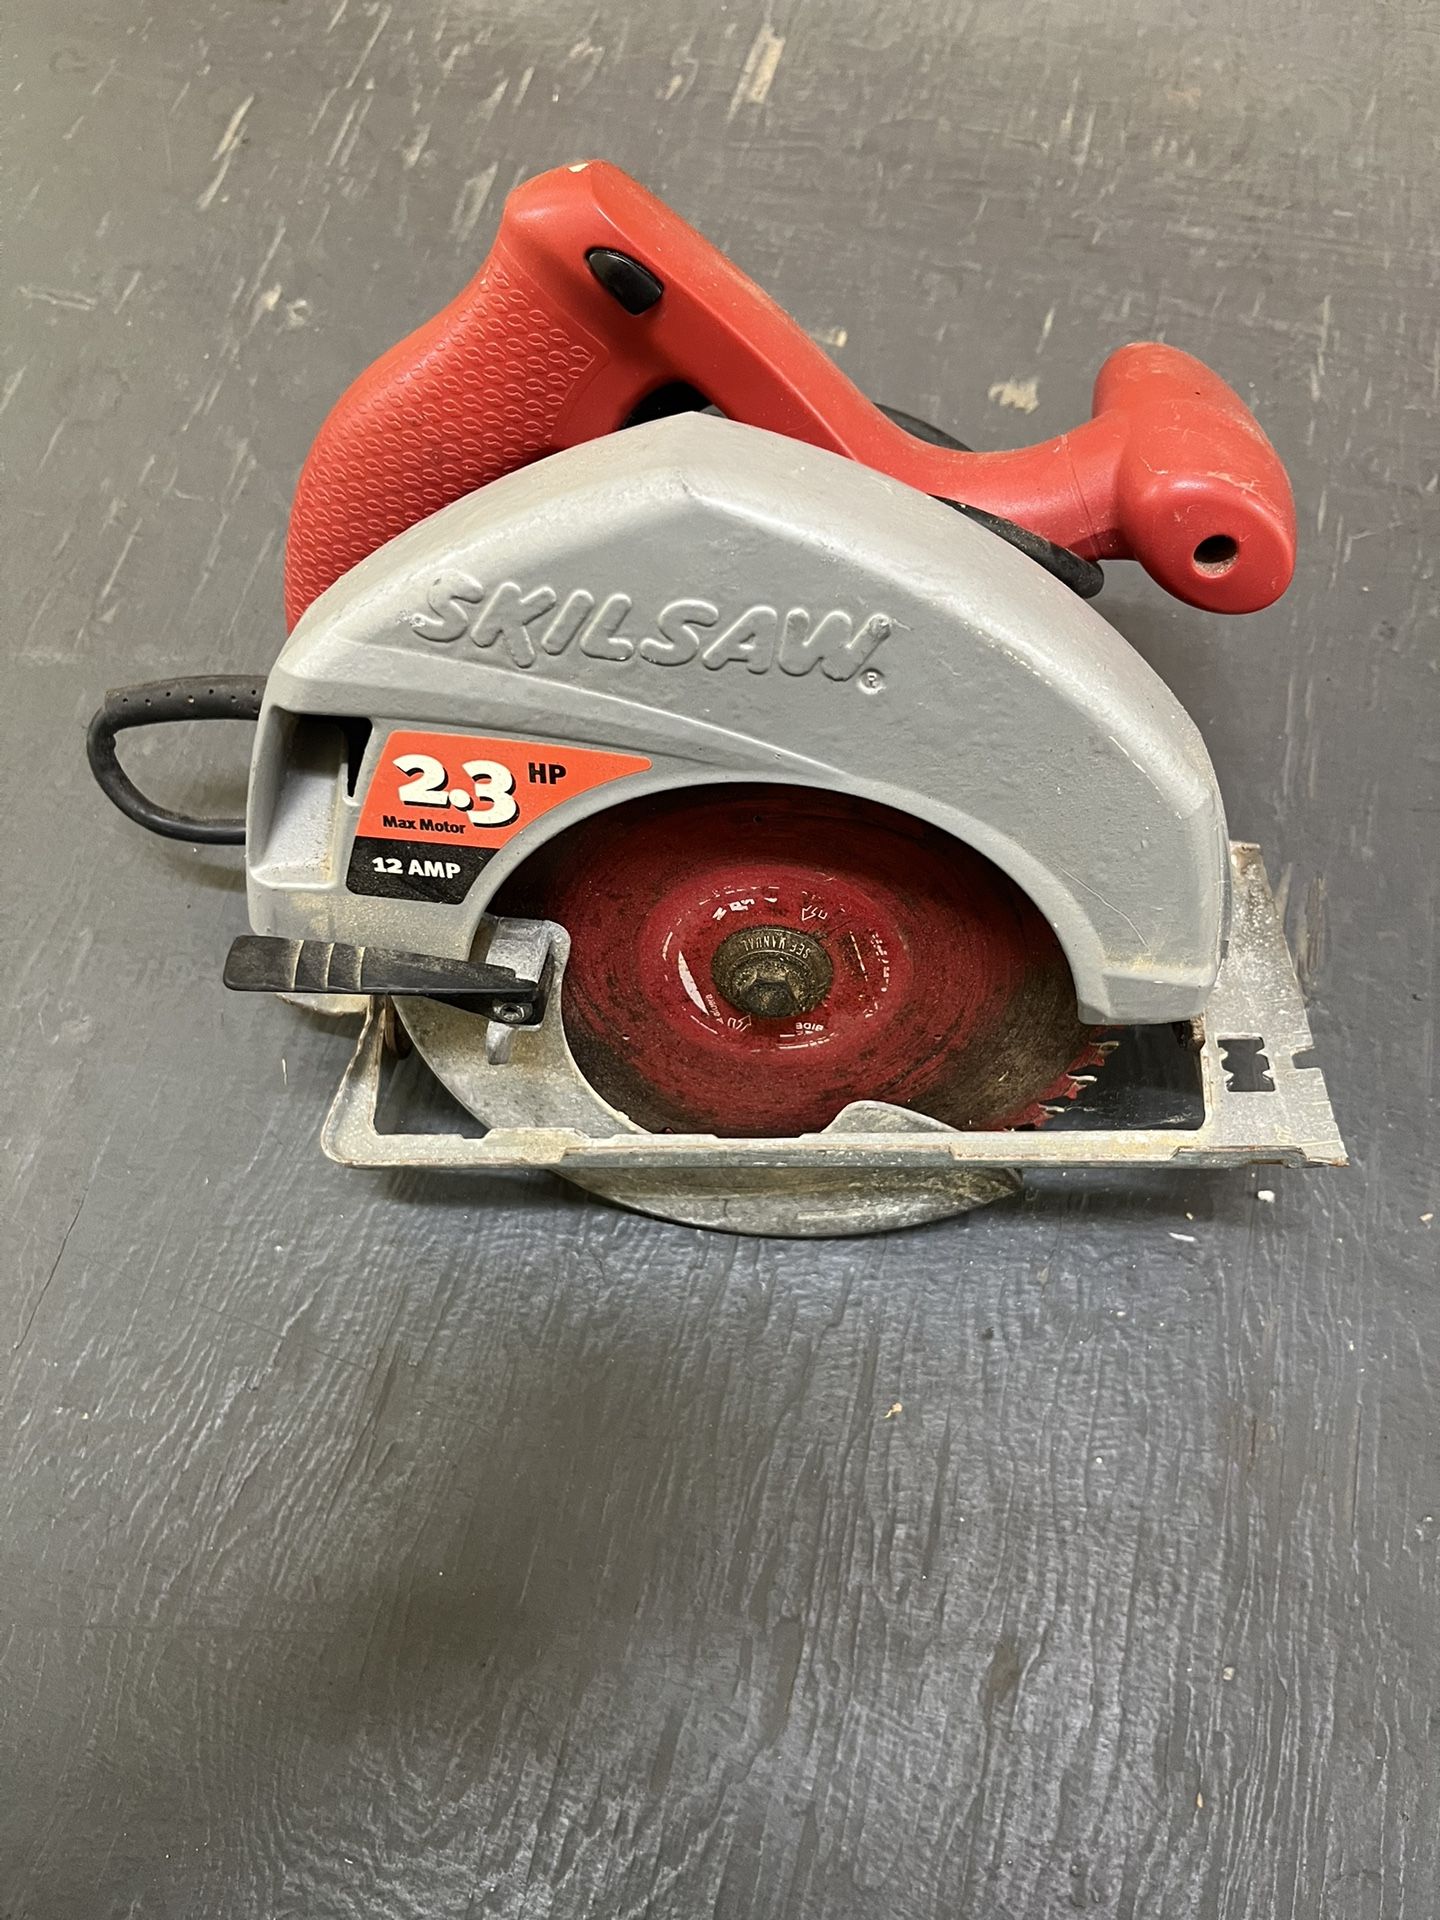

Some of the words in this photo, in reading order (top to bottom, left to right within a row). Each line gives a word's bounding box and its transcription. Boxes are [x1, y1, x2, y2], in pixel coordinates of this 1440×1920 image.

[411, 569, 891, 682] SKILSAW
[392, 754, 520, 828] 2.3
[528, 762, 567, 784] HP
[383, 815, 417, 830] Max
[419, 817, 466, 834] Motor
[372, 856, 403, 875] 12
[408, 859, 461, 879] AMP
